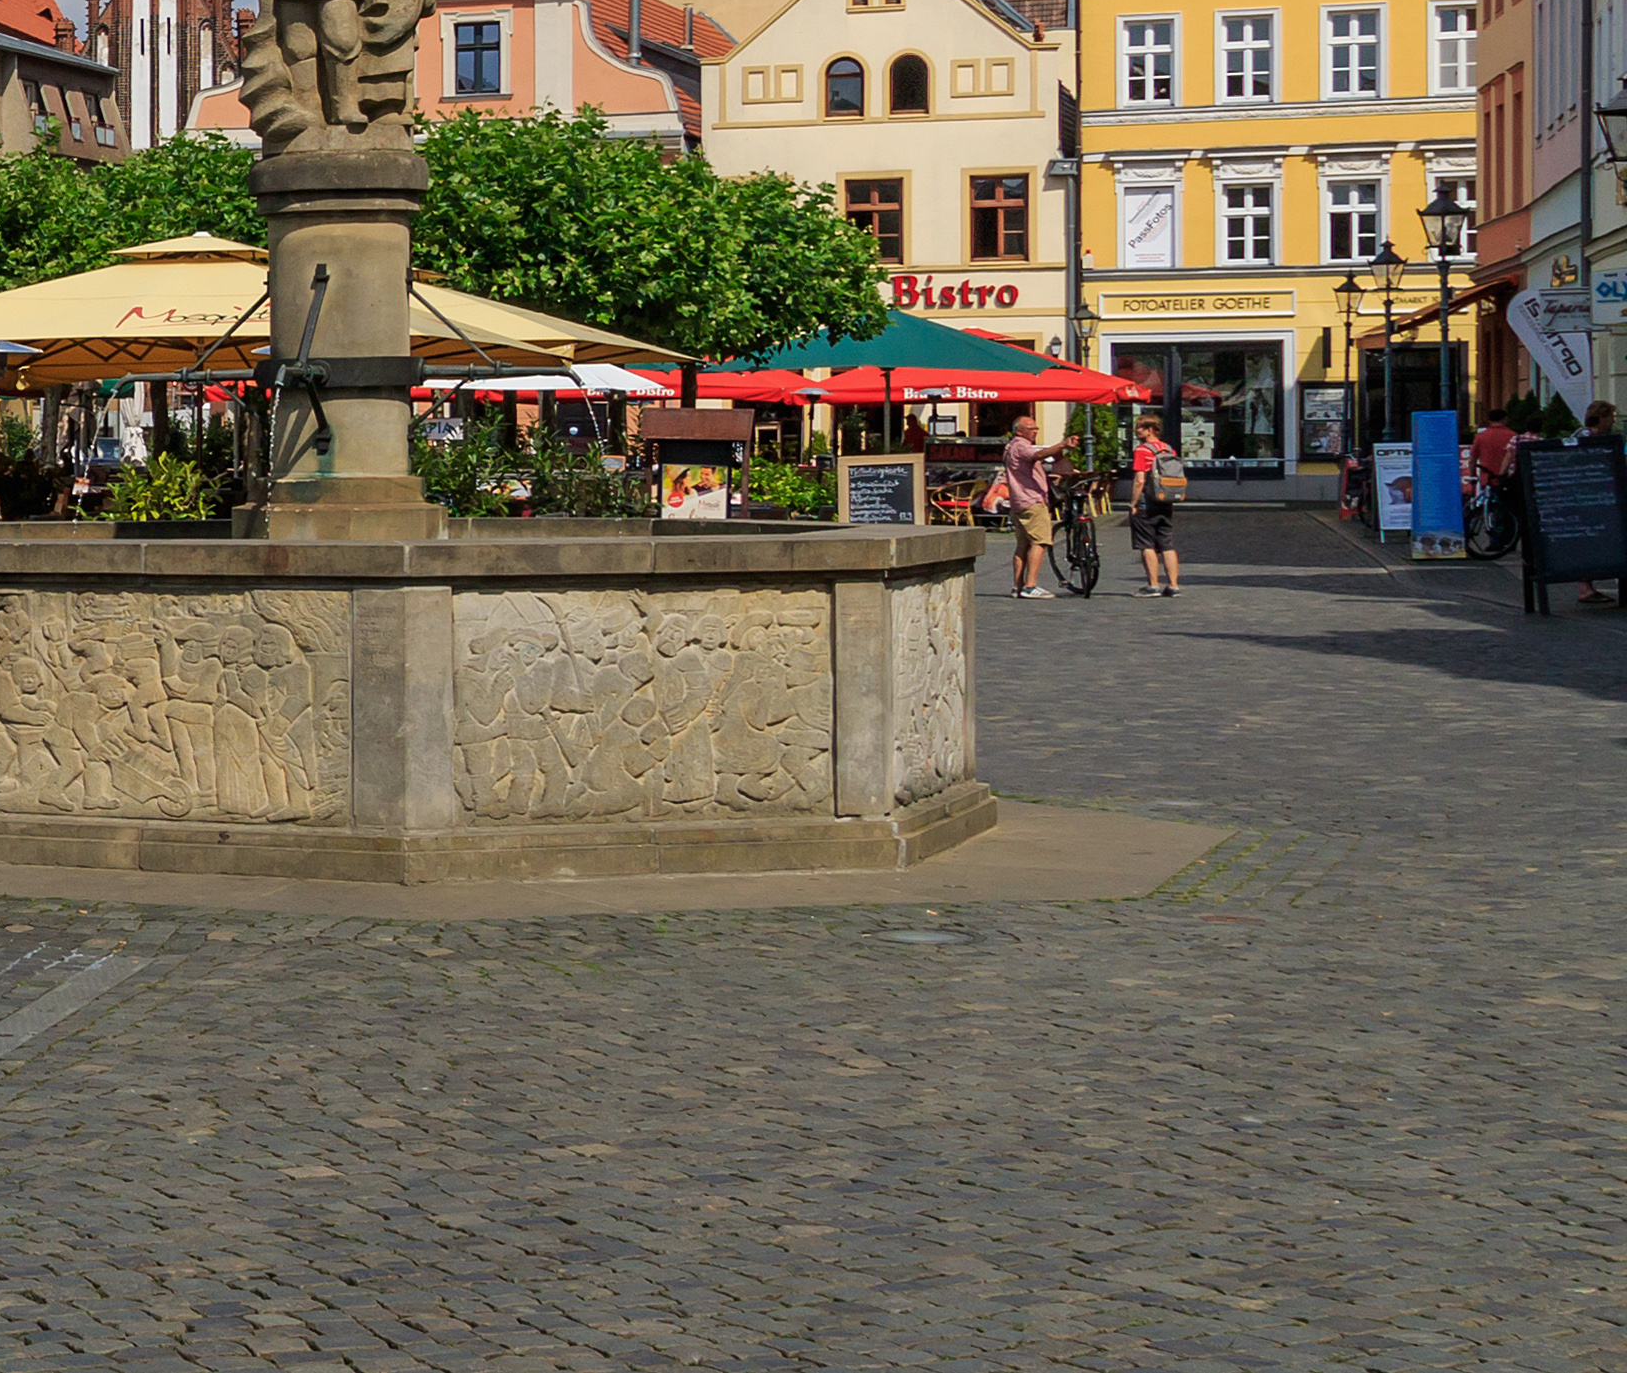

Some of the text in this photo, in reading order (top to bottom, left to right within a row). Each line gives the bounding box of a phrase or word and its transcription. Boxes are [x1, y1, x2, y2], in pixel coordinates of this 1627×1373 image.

[890, 275, 1019, 306] Bistro
[1123, 297, 1271, 312] FOTOATELIER GOETHE
[956, 385, 999, 399] Bistro
